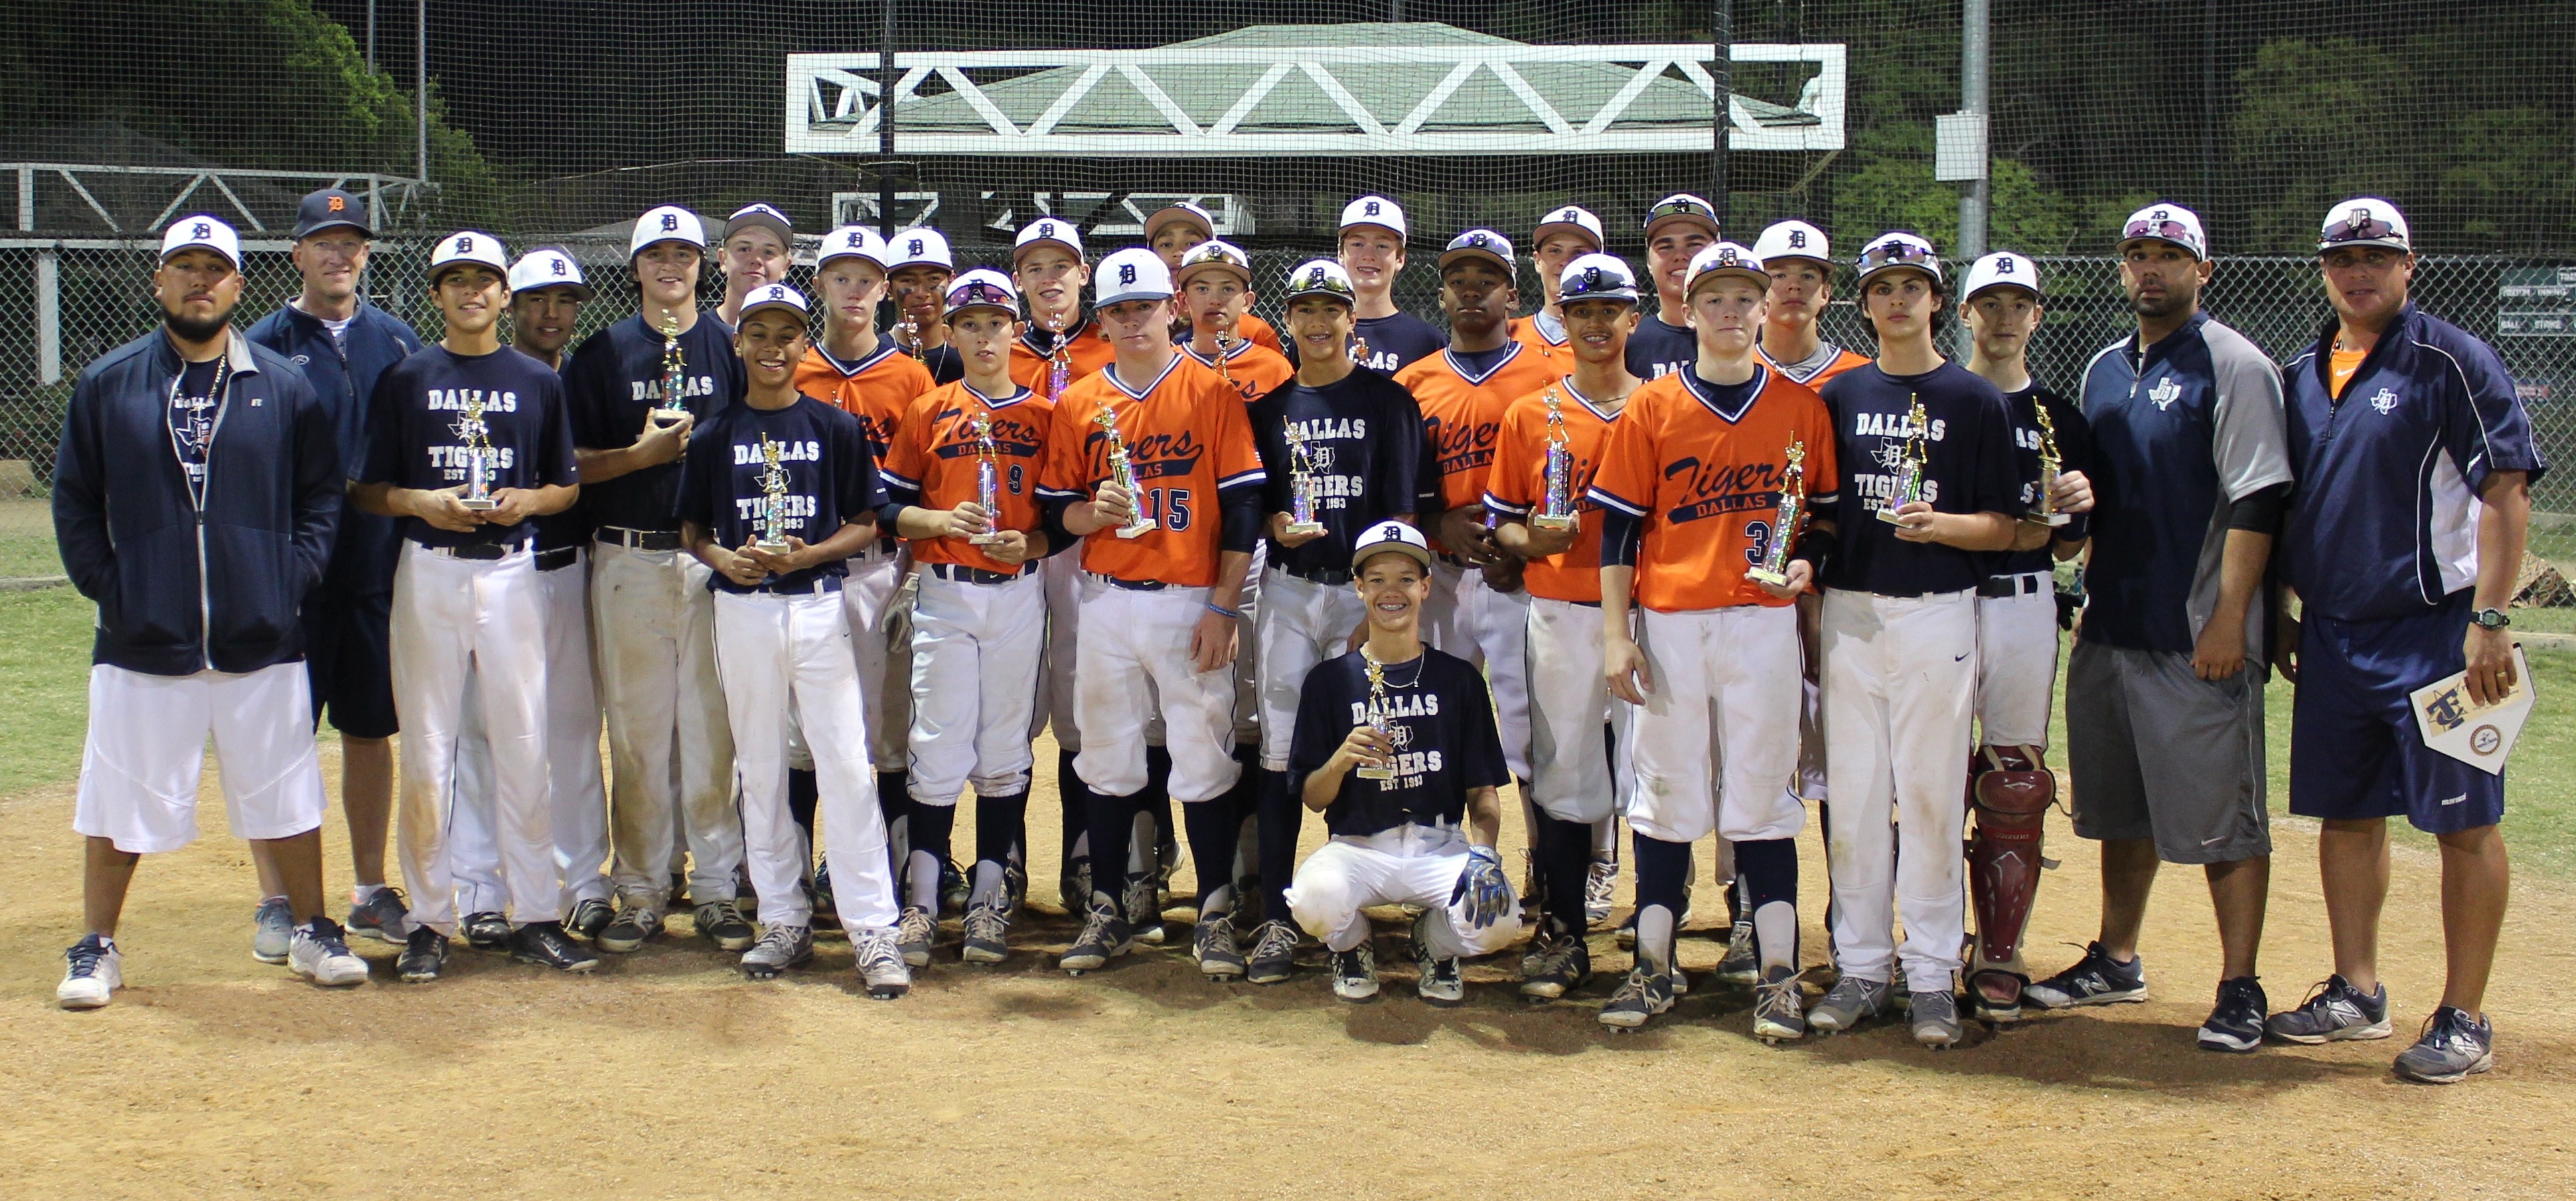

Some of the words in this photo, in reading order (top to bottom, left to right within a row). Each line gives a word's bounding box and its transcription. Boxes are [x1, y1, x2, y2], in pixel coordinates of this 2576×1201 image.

[328, 197, 344, 212] D
[1364, 201, 1380, 218] D
[191, 222, 211, 241] D
[660, 214, 678, 234] D
[1039, 222, 1054, 239] D
[455, 237, 473, 255] D
[846, 232, 863, 248] D
[907, 238, 923, 259] D
[1789, 230, 1805, 249] D
[550, 258, 566, 276] D
[1118, 264, 1136, 287] D
[1995, 257, 2014, 276] D
[769, 286, 785, 300] D
[631, 376, 713, 400] DAAS
[935, 408, 1042, 447] Tiers
[1286, 418, 1365, 445] ALLAS
[1424, 416, 1499, 458] Tige
[1856, 413, 1946, 441] DALLS
[428, 445, 514, 469] TIGRS
[733, 441, 819, 465] DALAS
[957, 443, 1011, 455] DAAS
[1084, 430, 1204, 477] Ters
[1132, 463, 1162, 478] LAS
[1443, 452, 1493, 473] DALLA
[444, 469, 466, 480] EST
[1008, 463, 1024, 495] 9
[1291, 475, 1363, 497] GERS
[1855, 474, 1938, 503] TIGS
[736, 495, 816, 520] TIERS
[1149, 487, 1191, 531] 15
[1696, 495, 1767, 518] DALLAS
[753, 519, 766, 531] ES
[784, 518, 804, 529] 993
[1383, 526, 1401, 541] D
[1360, 750, 1442, 777] GERS
[1380, 778, 1399, 791] EST
[1404, 774, 1423, 789] 1993
